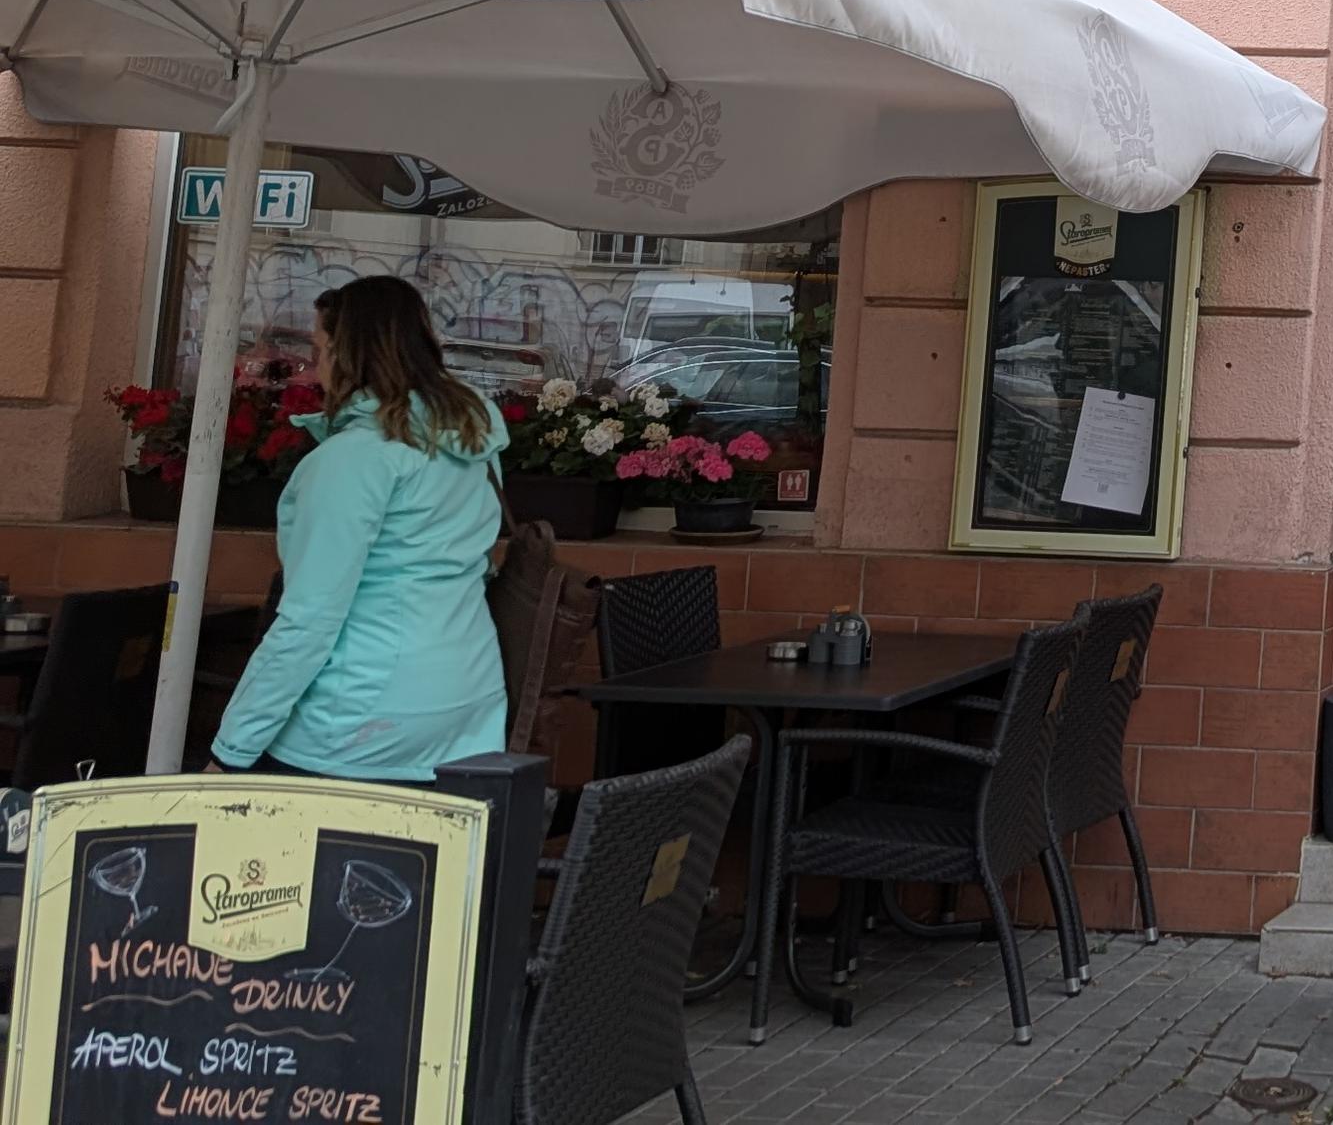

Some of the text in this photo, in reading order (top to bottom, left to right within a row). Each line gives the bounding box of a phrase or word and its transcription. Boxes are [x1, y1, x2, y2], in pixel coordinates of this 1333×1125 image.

[195, 178, 298, 218] WFi
[201, 873, 304, 924] Staropramen
[231, 979, 354, 1015] DRINKY
[71, 1027, 297, 1075] APEROL SPRITZ
[288, 1085, 383, 1123] SPRITZ
